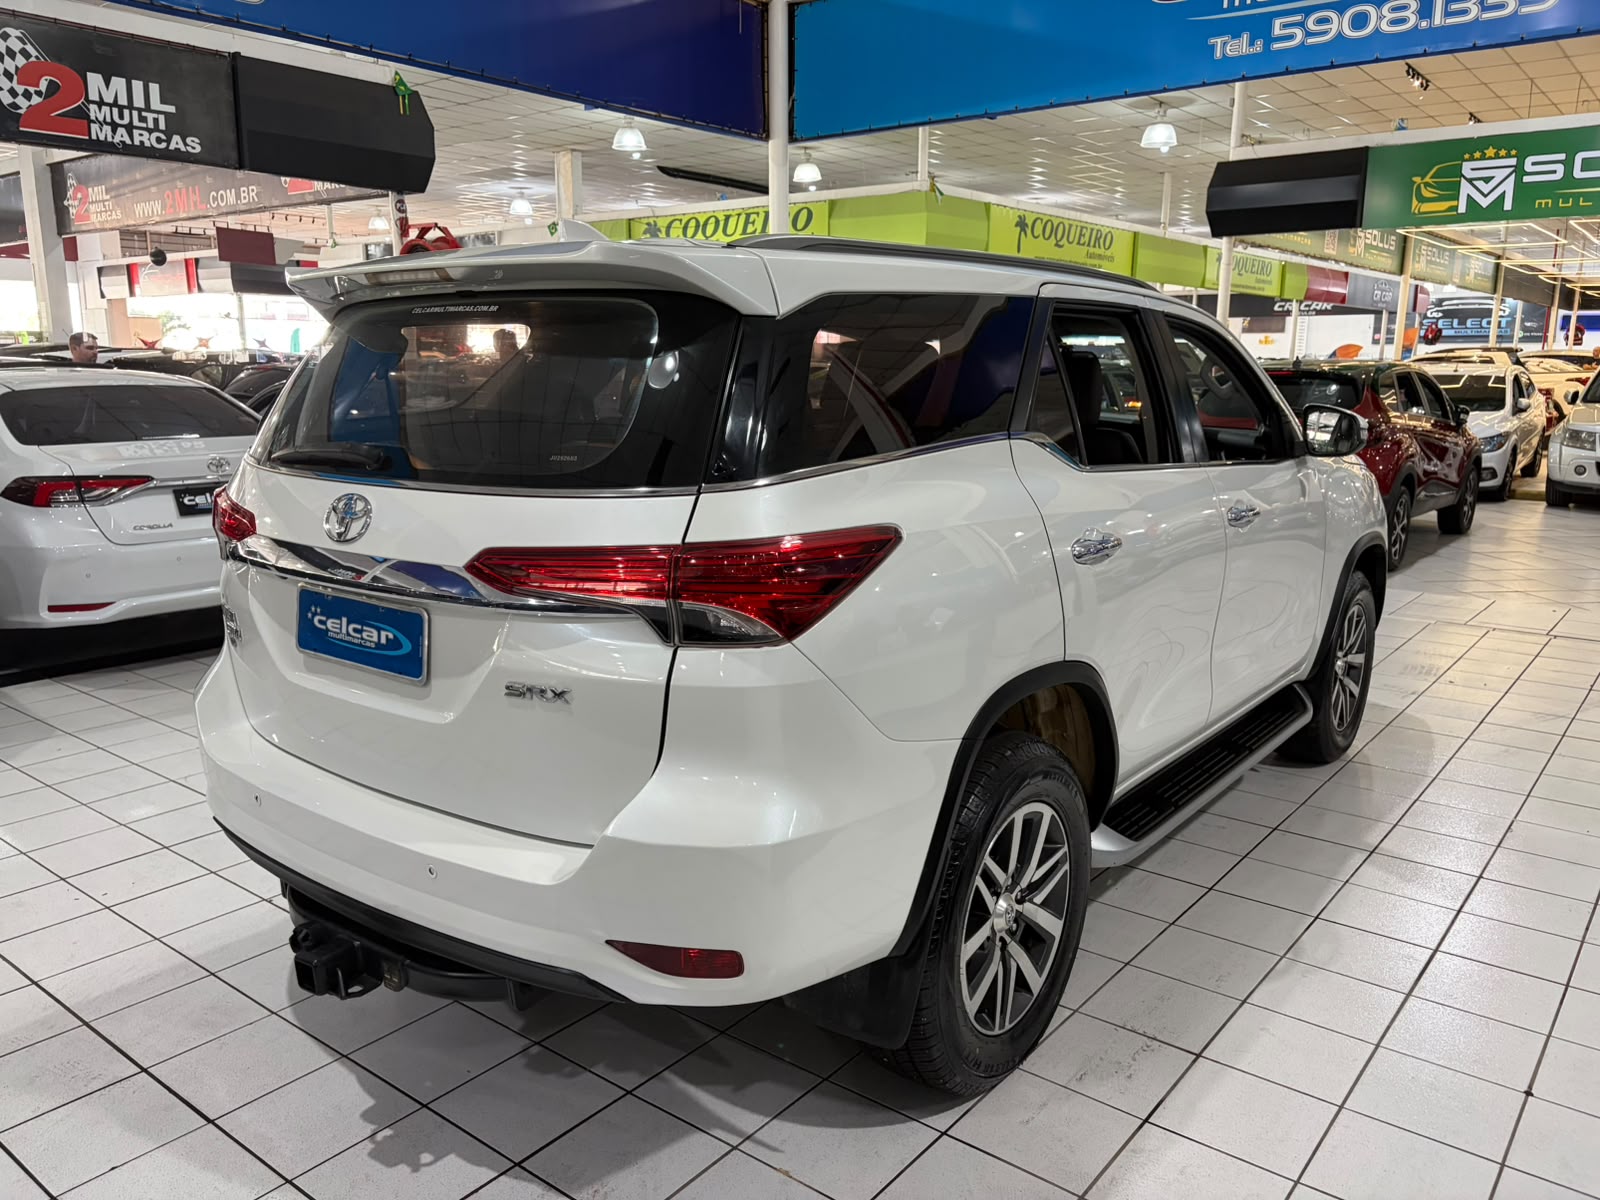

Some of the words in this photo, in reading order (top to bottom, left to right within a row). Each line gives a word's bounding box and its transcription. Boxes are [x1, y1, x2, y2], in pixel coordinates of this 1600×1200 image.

[16, 60, 89, 139] 2
[86, 72, 176, 113] MIL
[89, 103, 167, 131] MULTI
[90, 123, 202, 154] MARCAS
[88, 184, 111, 202] MIL
[665, 206, 814, 240] COQUEIO
[1029, 216, 1115, 251] COQUEIRO
[1232, 255, 1273, 278] OQUEIRO
[183, 492, 214, 505] cel
[313, 616, 395, 645] celcar
[327, 631, 376, 648] multimarcas
[504, 681, 573, 705] SRX
